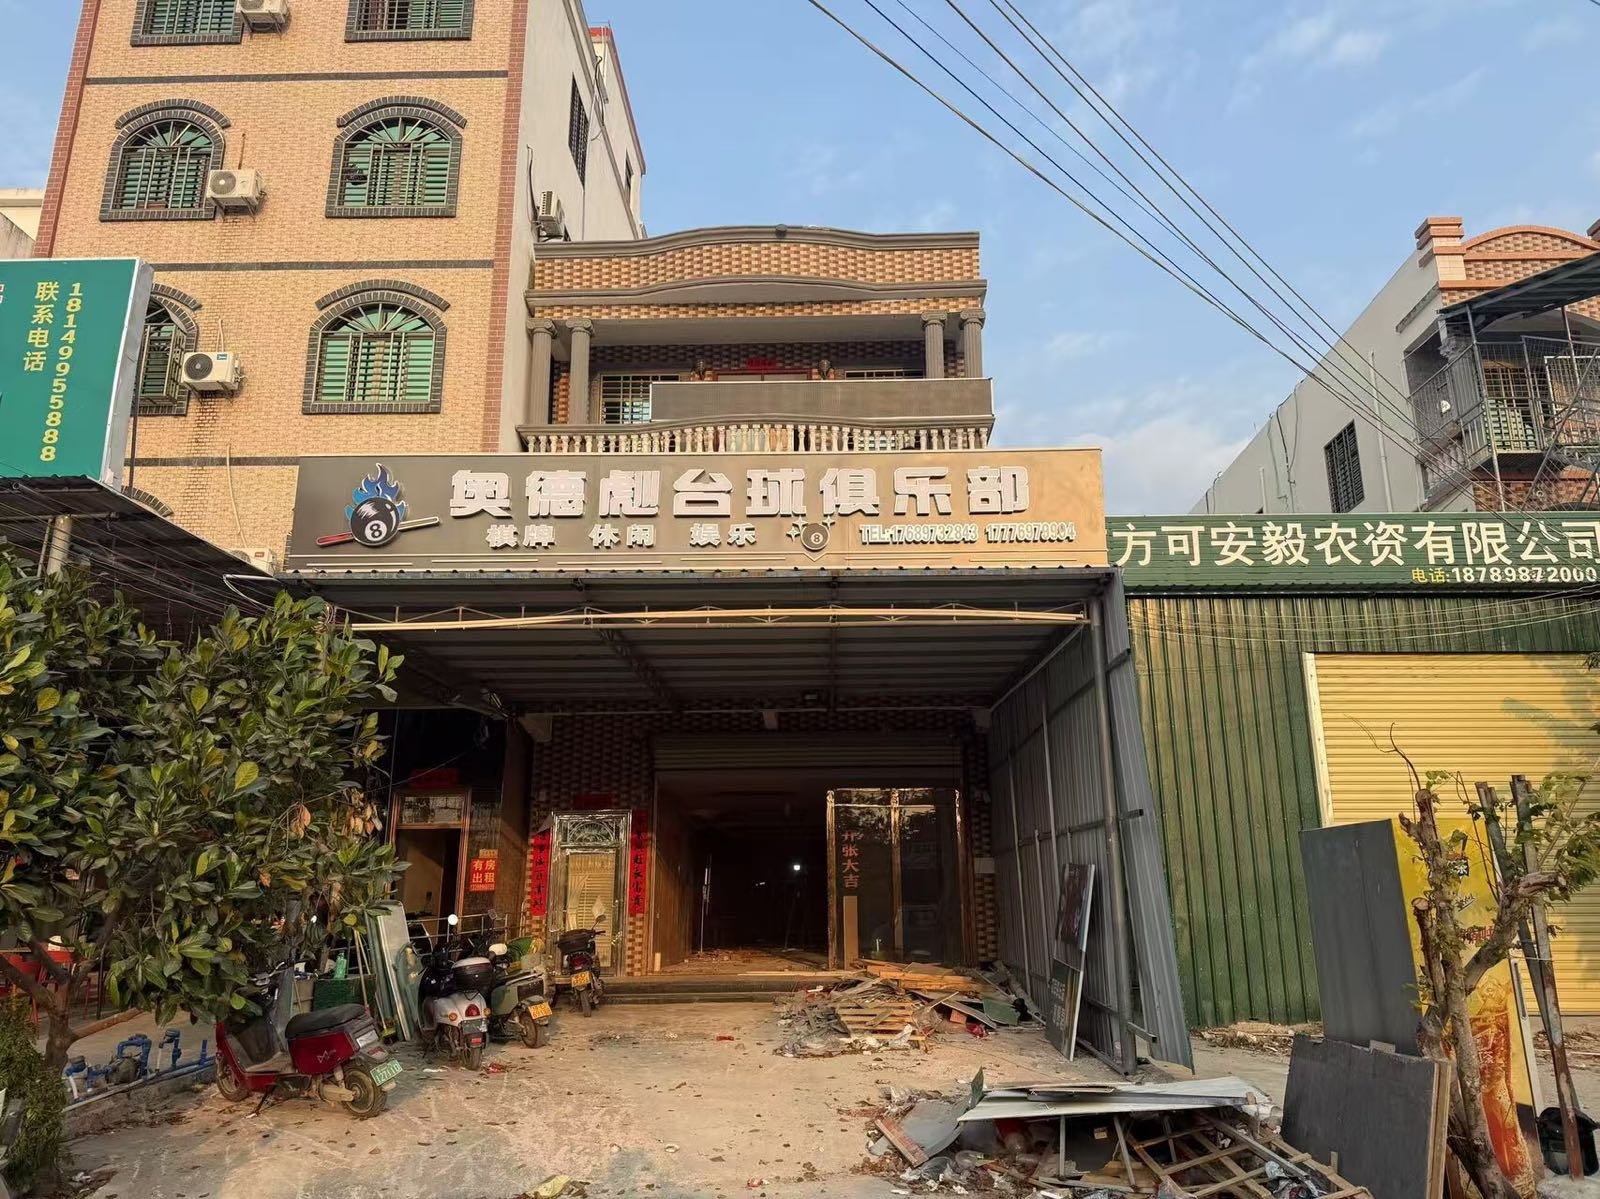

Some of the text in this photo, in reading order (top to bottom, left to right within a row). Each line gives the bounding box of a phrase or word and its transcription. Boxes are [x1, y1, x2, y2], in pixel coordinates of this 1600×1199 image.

[23, 281, 59, 372] 联系电话
[39, 282, 83, 462] 18149955888
[369, 523, 383, 539] 8
[485, 522, 757, 548] 棋牌 休闲 娱乐
[1112, 520, 1600, 567] 方可安毅农资有限公司
[472, 859, 496, 871] 有房
[472, 872, 496, 883] 出租
